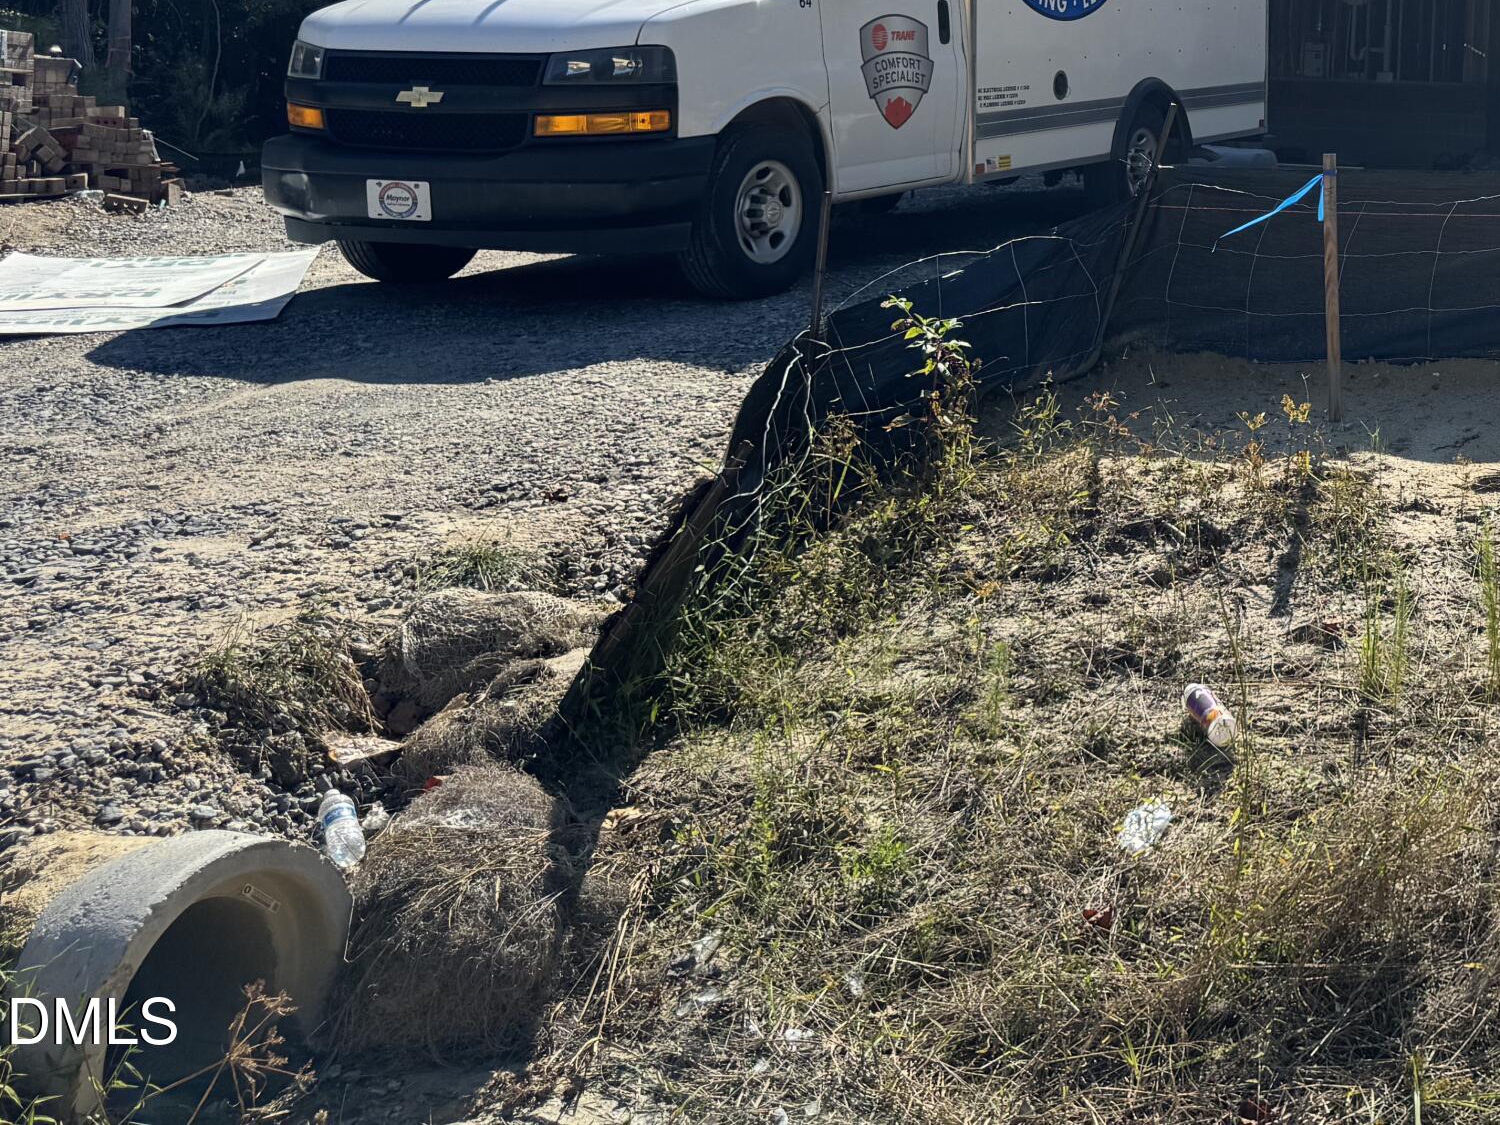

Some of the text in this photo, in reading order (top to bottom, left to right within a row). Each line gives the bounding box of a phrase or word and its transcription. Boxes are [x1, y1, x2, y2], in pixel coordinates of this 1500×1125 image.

[891, 30, 917, 41] TRANE
[874, 57, 921, 73] COMFORT
[872, 73, 927, 89] SPECIALIST
